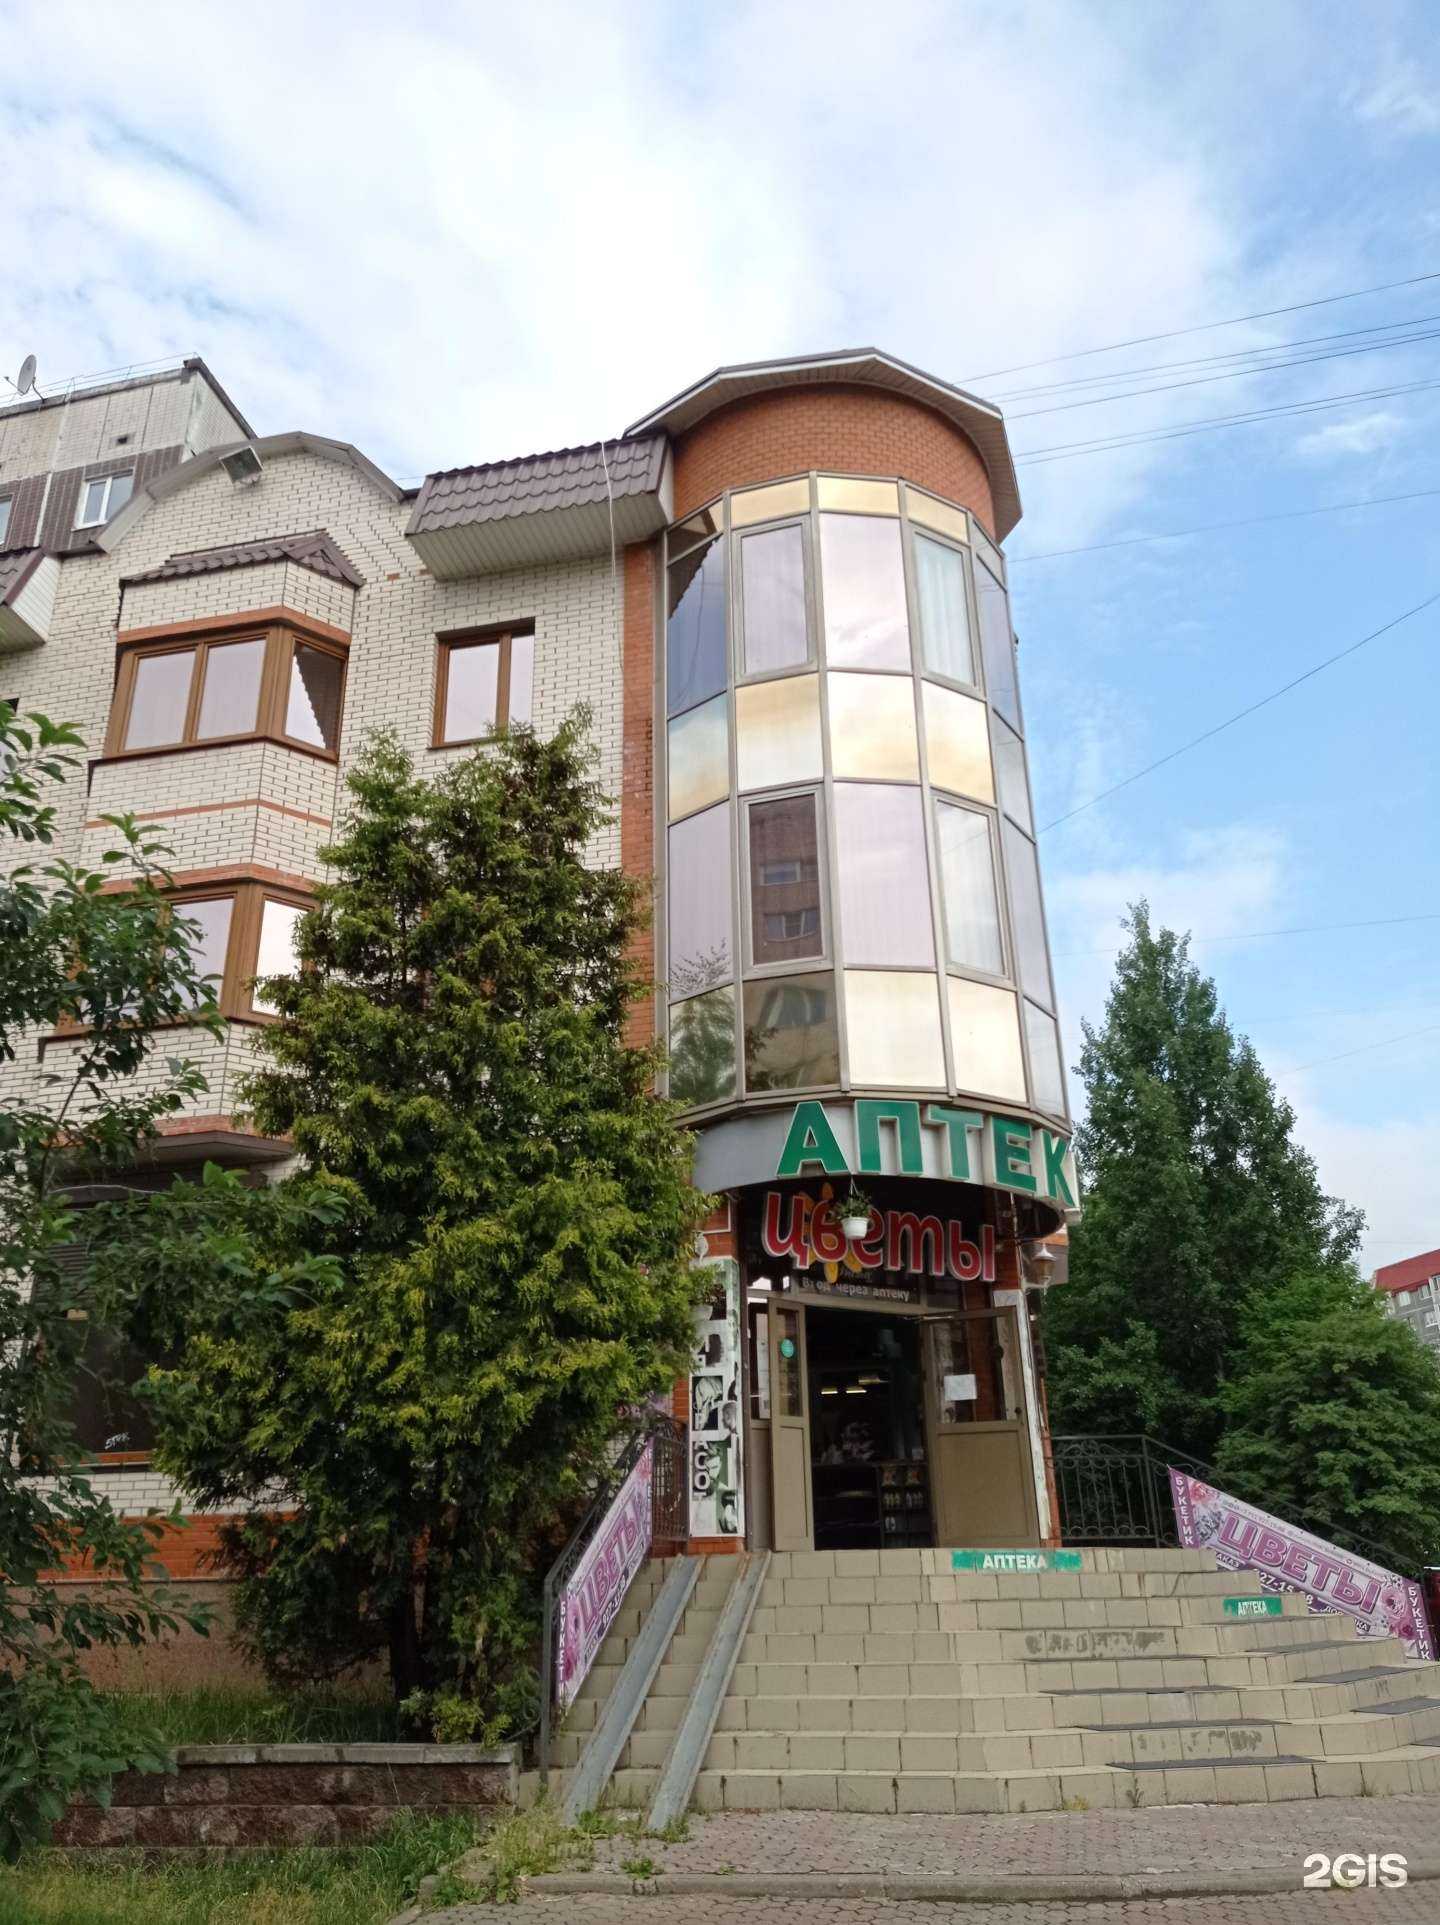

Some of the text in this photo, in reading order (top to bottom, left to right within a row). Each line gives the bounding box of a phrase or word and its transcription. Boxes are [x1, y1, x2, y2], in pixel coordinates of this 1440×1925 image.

[776, 1099, 1077, 1208] АПТЕК
[1174, 1476, 1194, 1545] БУКЕТИК
[982, 1553, 1048, 1570] АПТЕКА
[1216, 1552, 1242, 1569] АКАЗ
[1218, 1512, 1385, 1614] ЦВЕТЫ
[1237, 1600, 1268, 1617] АПТЕКА
[1408, 1586, 1431, 1661] БУКЕТИК
